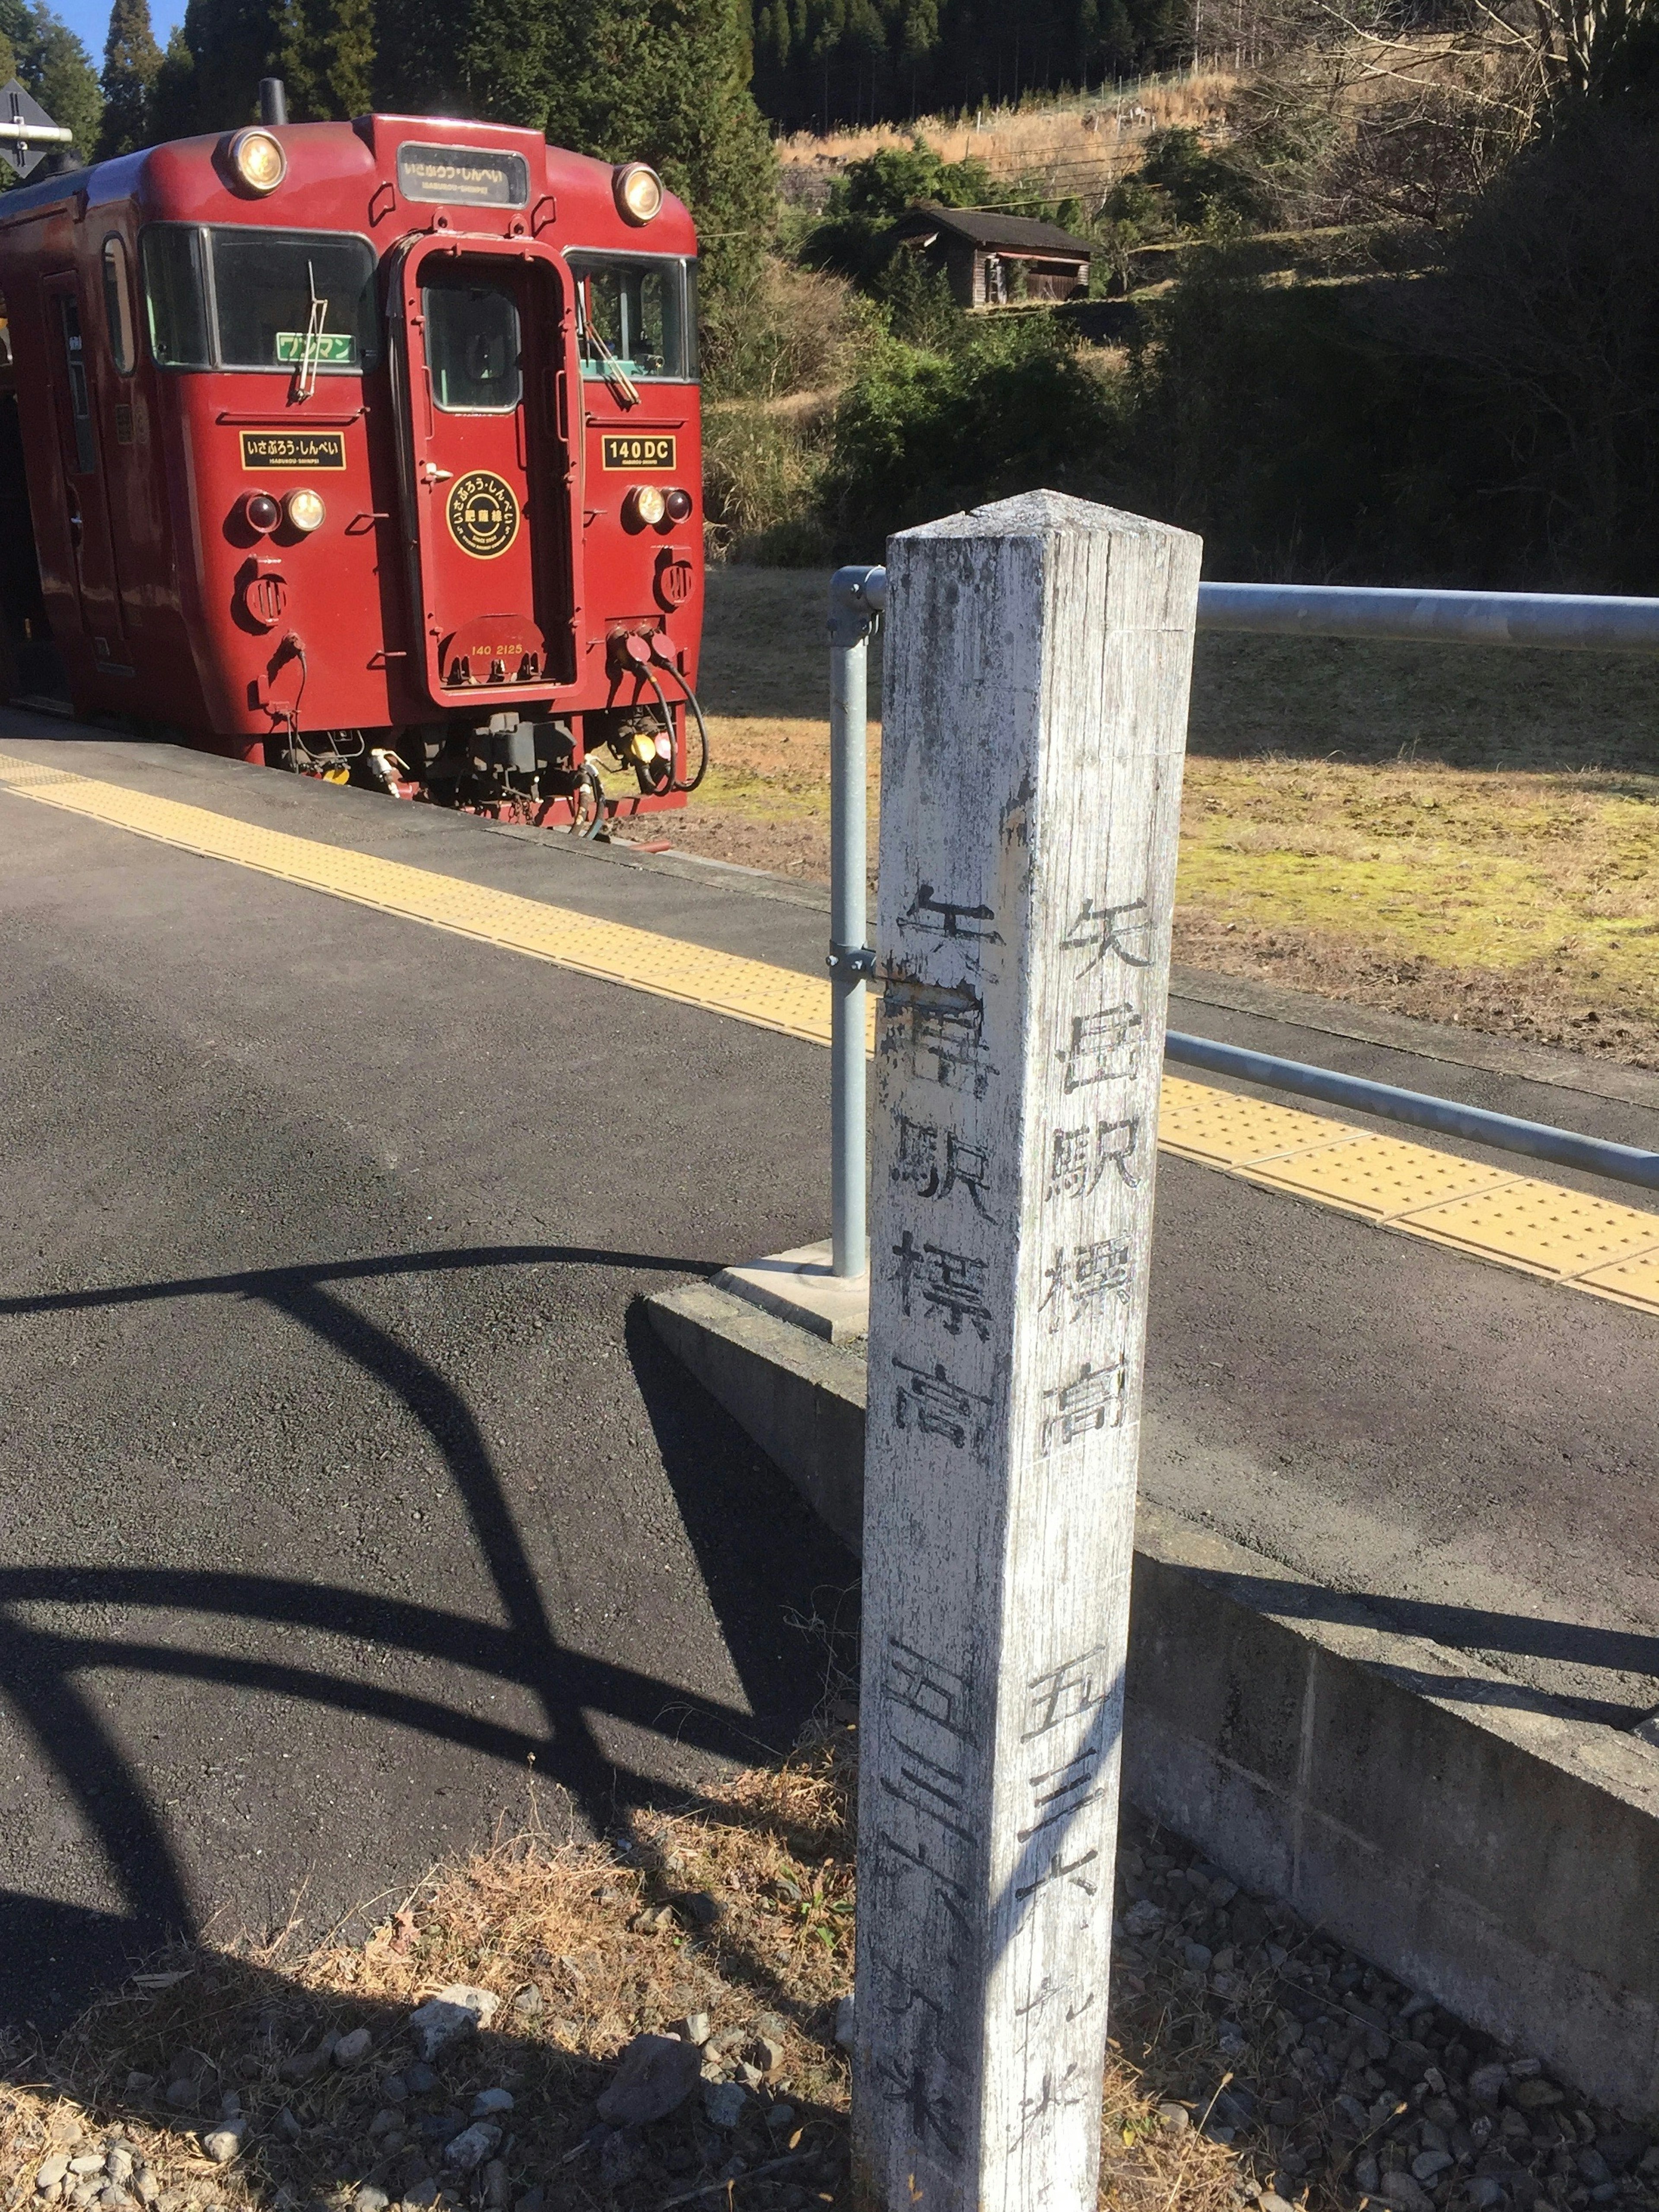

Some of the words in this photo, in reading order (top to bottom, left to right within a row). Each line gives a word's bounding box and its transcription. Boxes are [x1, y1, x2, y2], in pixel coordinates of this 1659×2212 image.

[247, 440, 339, 455] いさぶろう・しんぺい
[472, 646, 492, 656] 140
[496, 644, 523, 655] 2125
